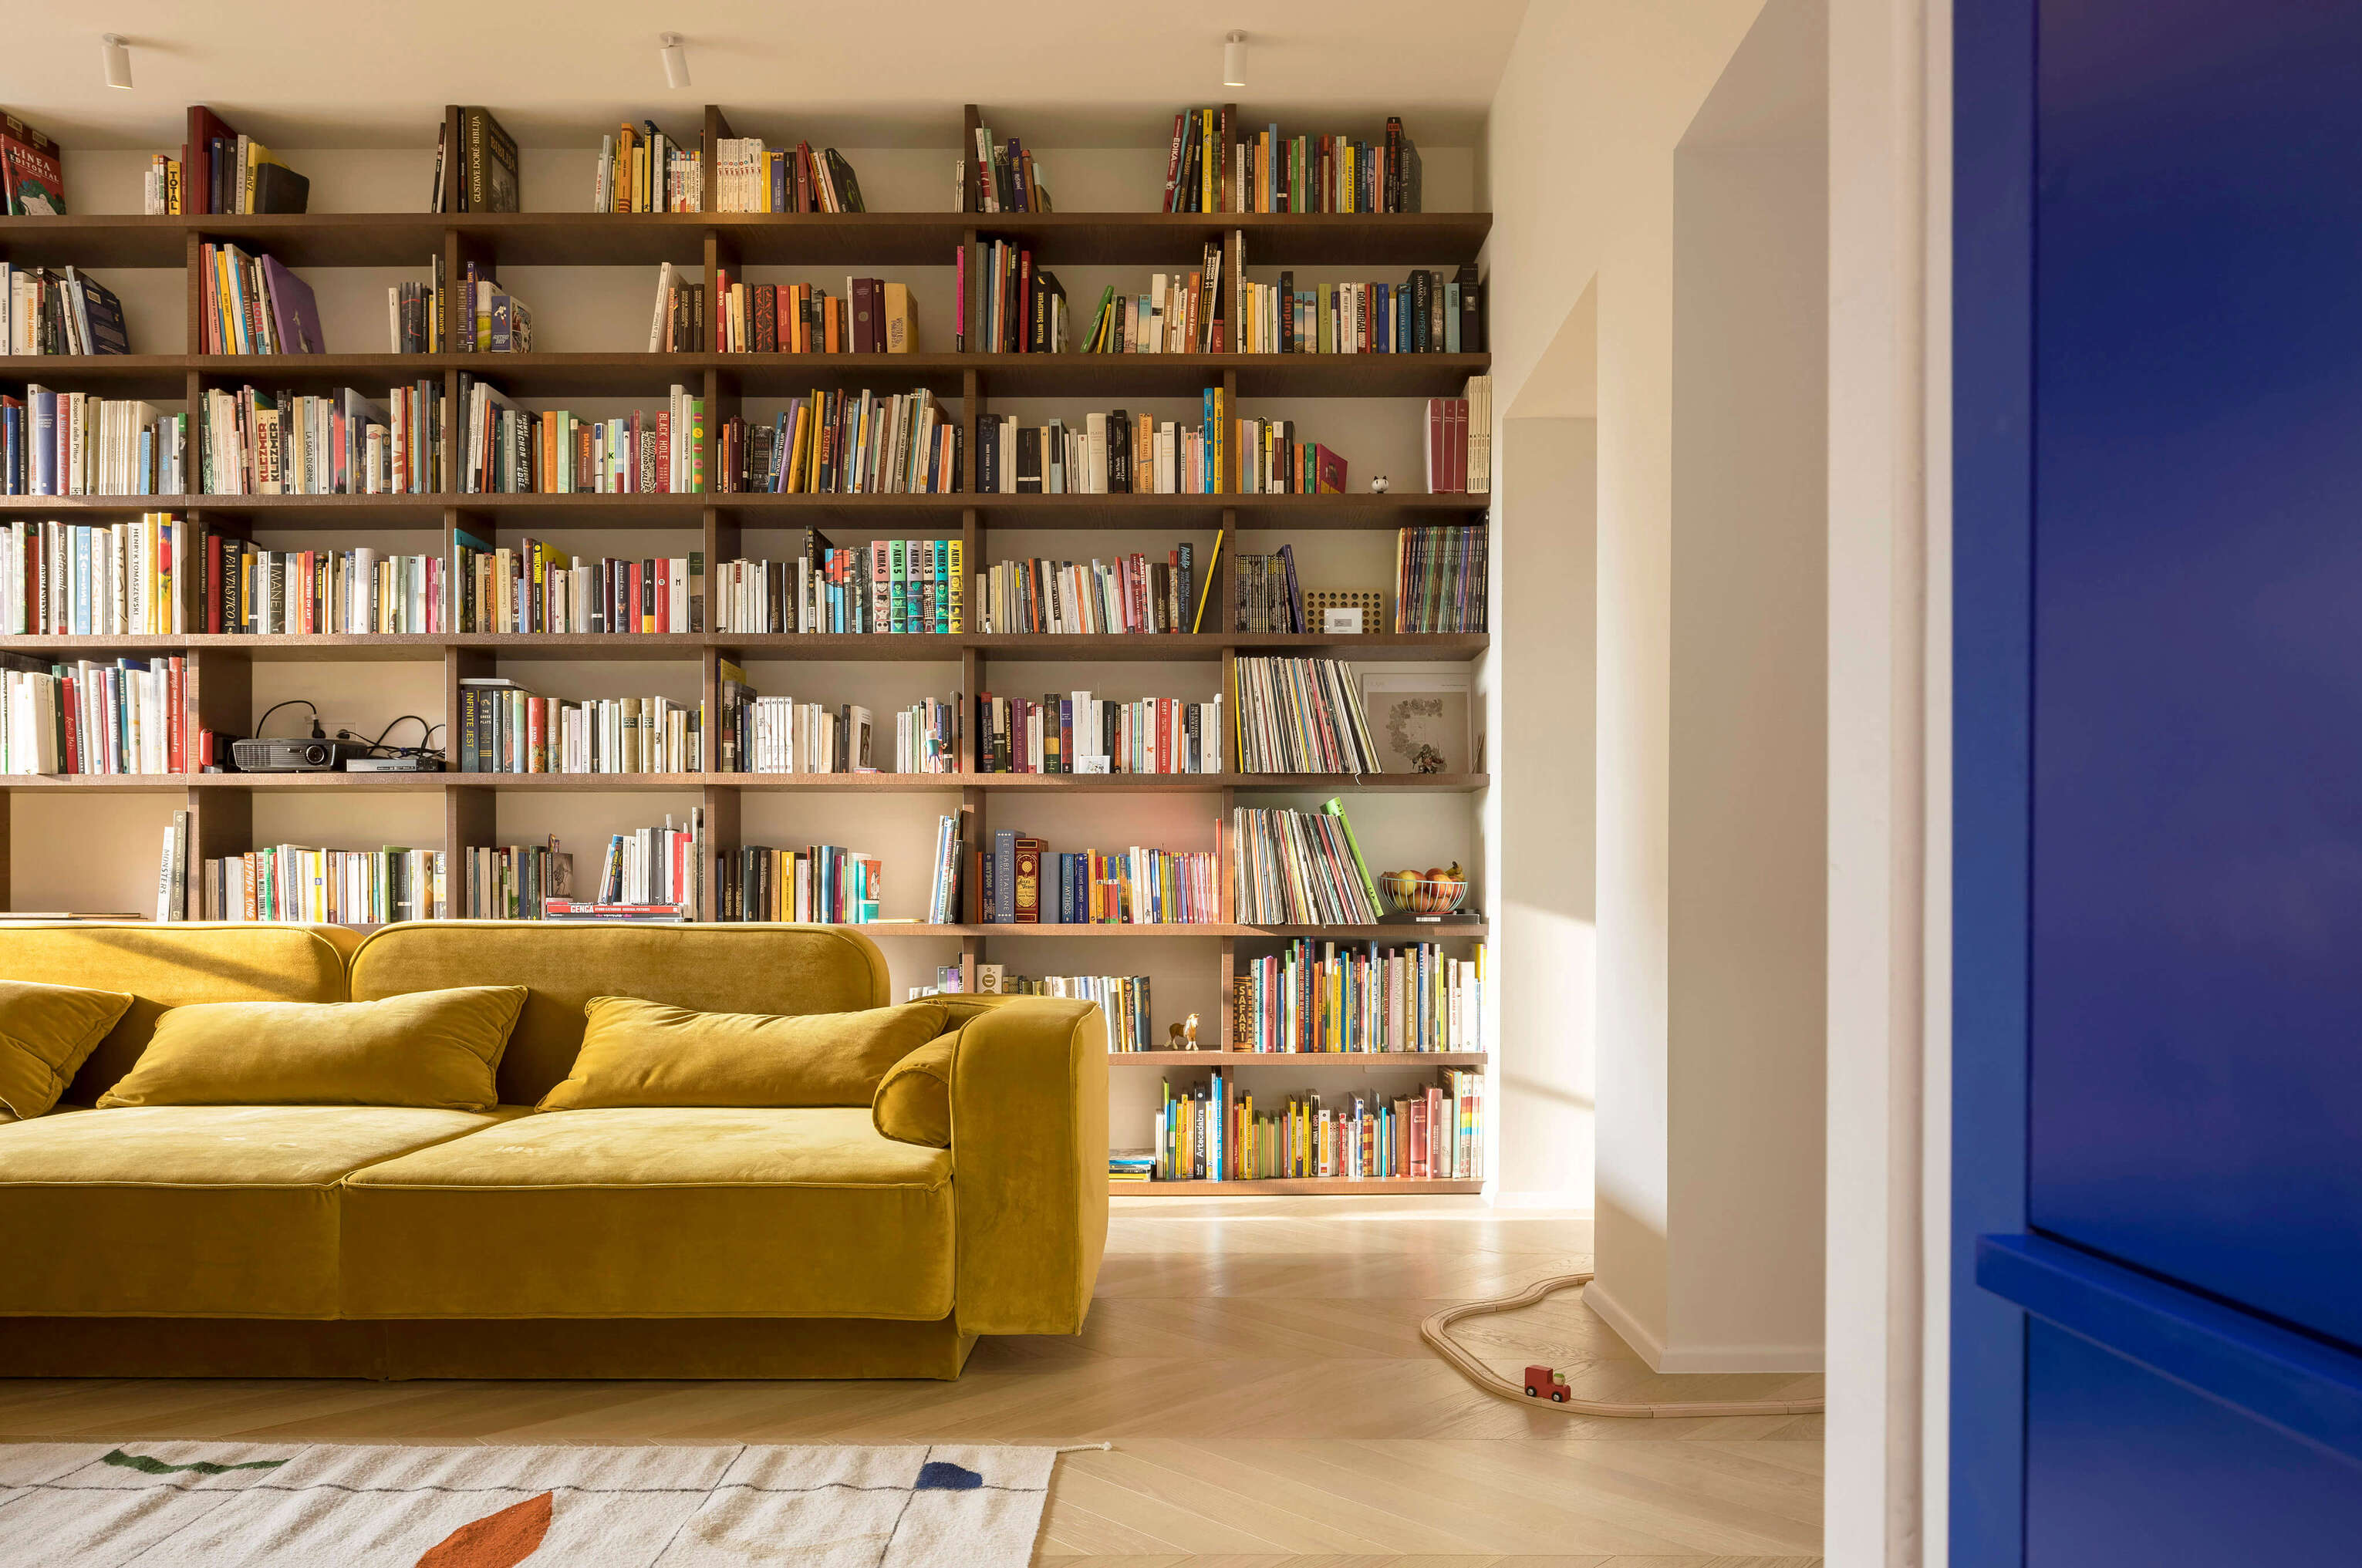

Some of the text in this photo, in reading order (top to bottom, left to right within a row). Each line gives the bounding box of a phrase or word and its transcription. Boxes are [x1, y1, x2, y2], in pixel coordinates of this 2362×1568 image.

[10, 153, 60, 182] EDITORIAL
[13, 146, 52, 171] LÍNEA
[471, 116, 481, 202] GUSTAVE DORÉ BIBLIJA
[491, 135, 515, 172] BIBLIJA
[1170, 137, 1180, 162] ÉDIKA
[170, 171, 178, 210] TOTAL
[252, 302, 264, 333] KOMA
[1284, 296, 1293, 337] Empire
[1357, 292, 1366, 332] GOMORRAH
[258, 423, 268, 482] KLEZMER
[268, 423, 279, 482] KLEZMER
[516, 419, 526, 457] PYNCHON
[659, 413, 668, 460] BLACK HOLE
[517, 467, 525, 487] EDGE
[877, 549, 886, 568] AKIRA
[910, 549, 919, 568] AKIRA
[950, 549, 959, 568] AKIRA
[224, 554, 236, 619] FANTASTICO
[271, 569, 282, 615] MANET
[306, 599, 312, 607] ON
[466, 692, 474, 748] INFINITE JEST
[160, 848, 170, 895] MONSTERS
[245, 853, 256, 919] STEPHEN KING
[1238, 986, 1247, 1041] SAFARI
